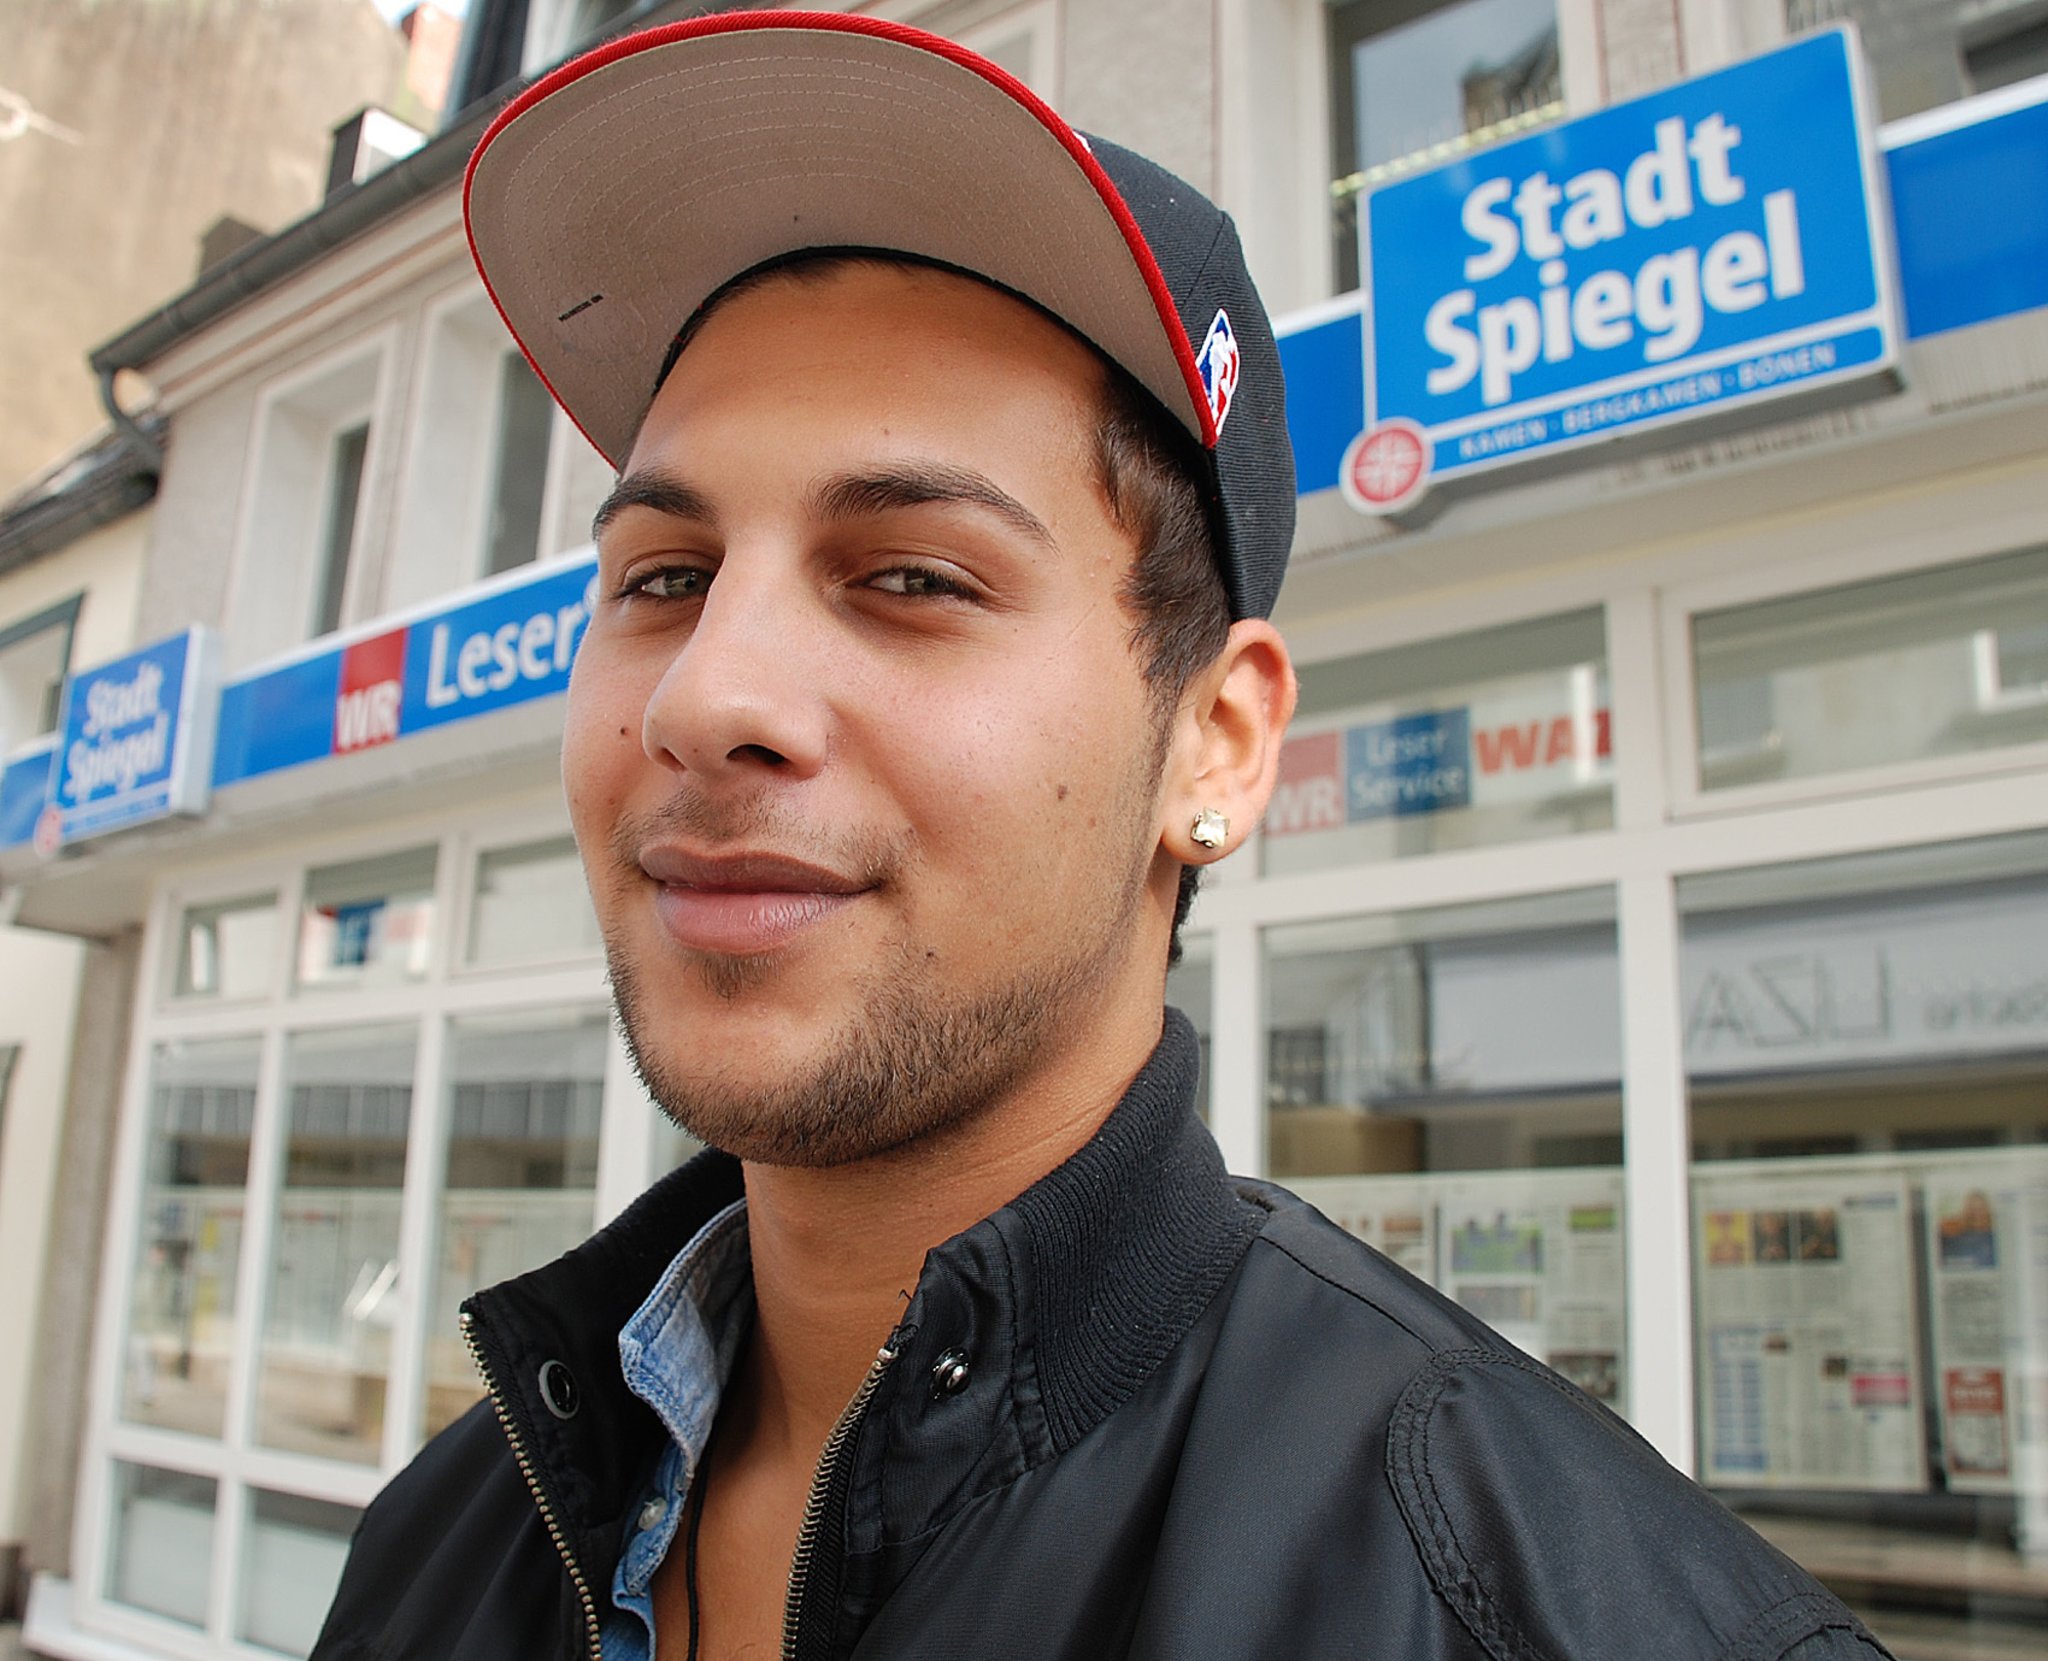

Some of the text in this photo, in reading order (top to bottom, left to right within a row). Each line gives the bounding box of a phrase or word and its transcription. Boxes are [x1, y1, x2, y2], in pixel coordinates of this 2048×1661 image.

[1460, 112, 1746, 282] Stadt
[1423, 188, 1806, 407] Spiegel
[83, 661, 163, 738] Stadt
[337, 678, 400, 749] WR
[63, 711, 170, 804] Spiegel
[1351, 765, 1465, 808] Service
